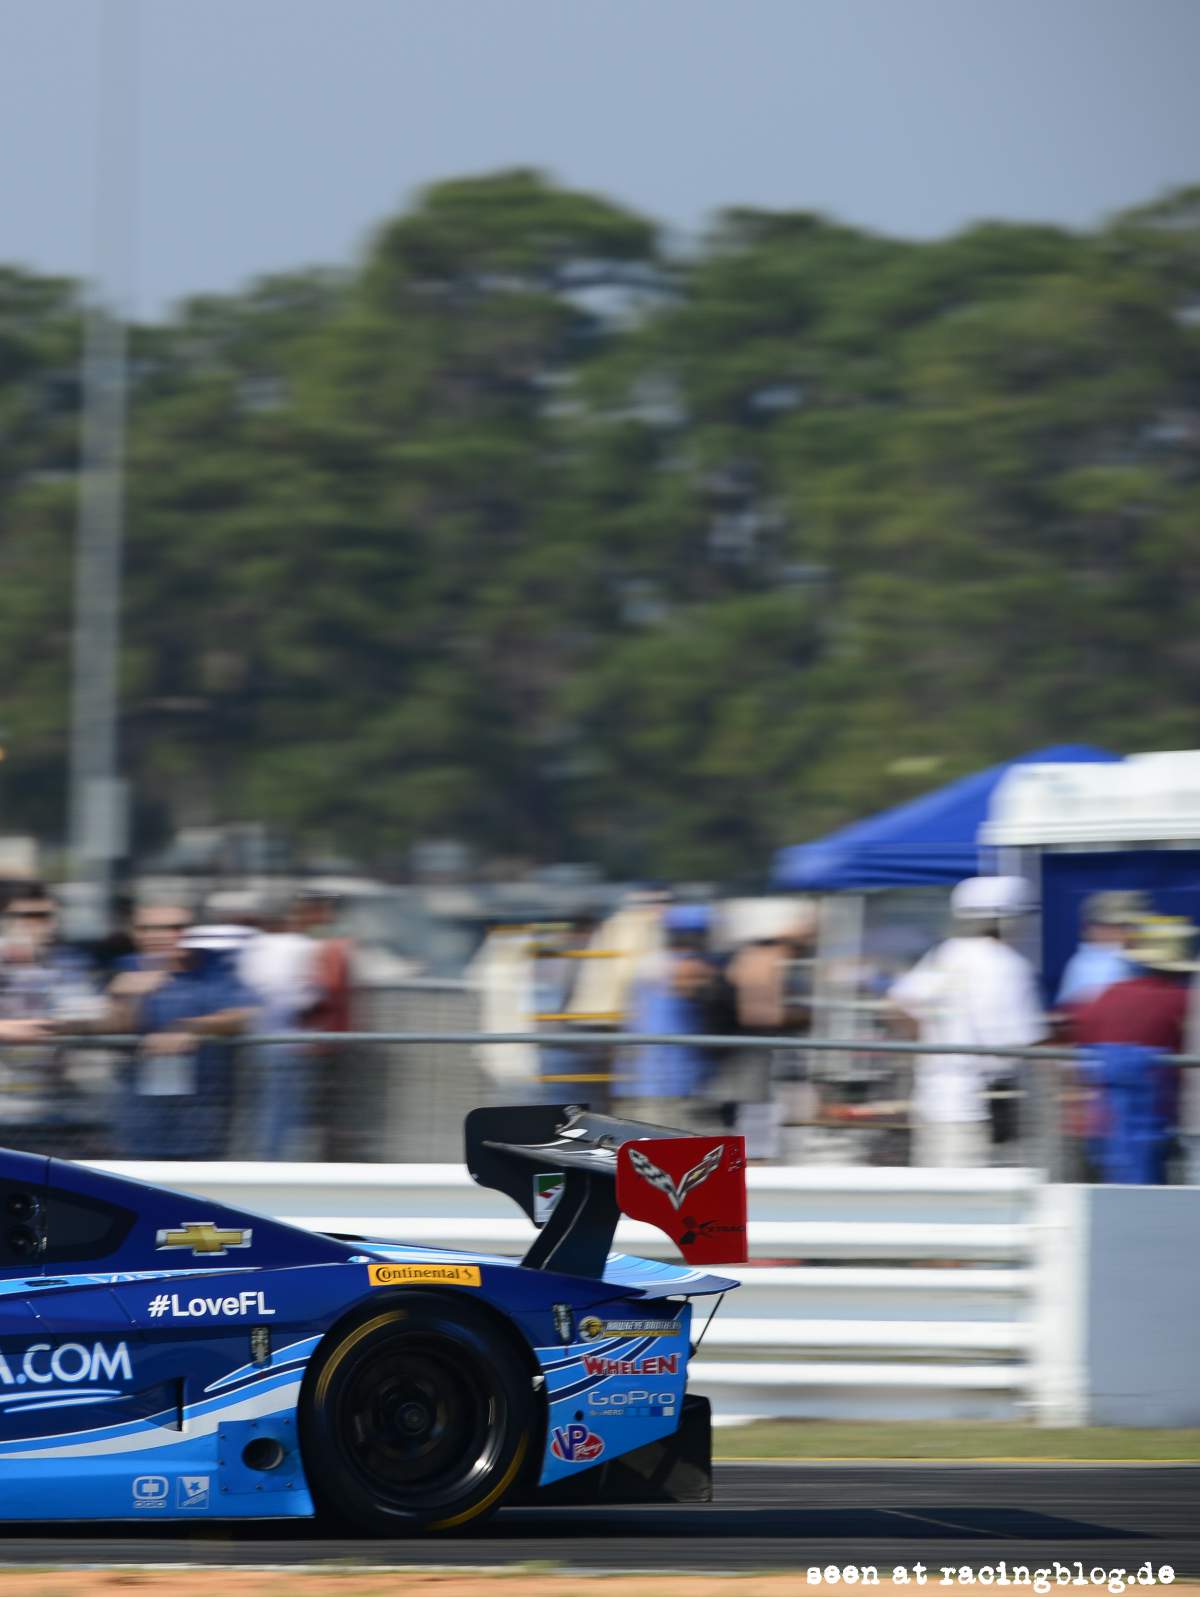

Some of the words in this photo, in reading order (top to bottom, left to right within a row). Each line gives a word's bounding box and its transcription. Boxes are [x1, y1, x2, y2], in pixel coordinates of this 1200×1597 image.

[375, 1266, 460, 1282] Continental
[147, 1291, 275, 1317] #LoveFL
[582, 1353, 681, 1375] WHELEN
[588, 1391, 675, 1405] GoPro
